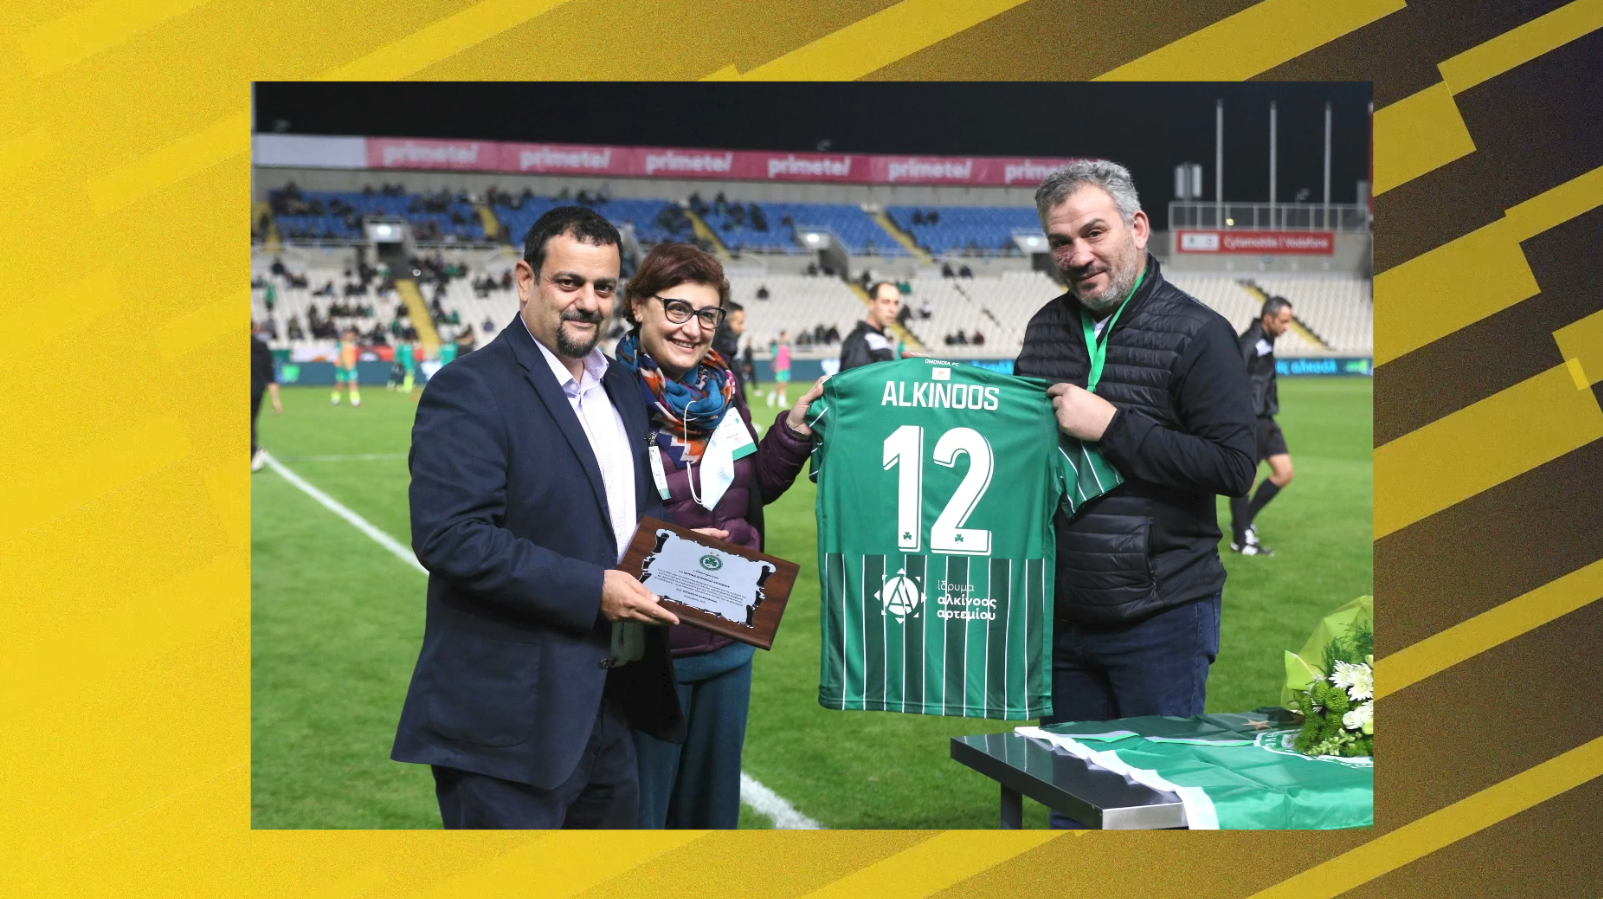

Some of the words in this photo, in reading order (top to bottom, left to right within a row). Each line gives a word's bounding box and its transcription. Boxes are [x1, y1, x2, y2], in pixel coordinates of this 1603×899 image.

[383, 142, 479, 167] primetel
[520, 147, 612, 172] primetel
[645, 150, 733, 174] primetel
[768, 154, 851, 179] primetel
[888, 158, 972, 182] primetel
[880, 380, 1000, 411] ALKINOOS
[881, 424, 995, 556] 12
[936, 594, 998, 610] αλκίνοος
[936, 608, 997, 622] αρτεμίου
